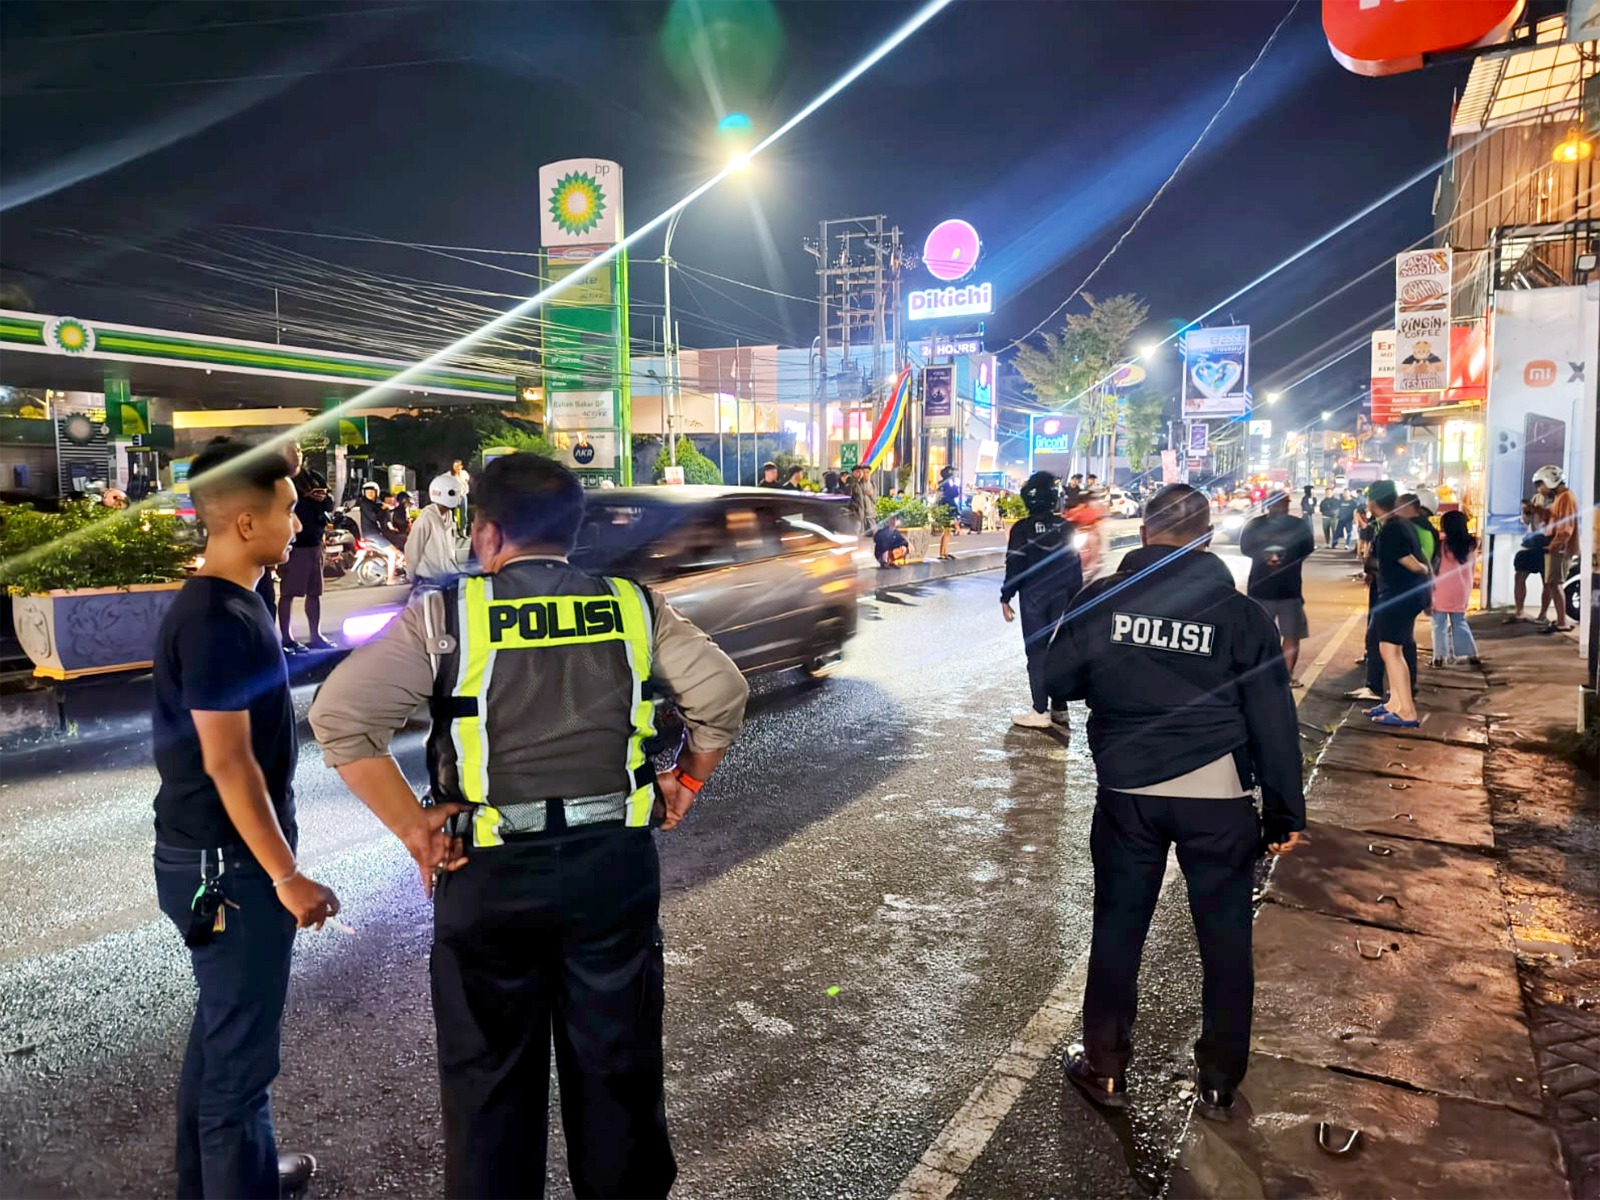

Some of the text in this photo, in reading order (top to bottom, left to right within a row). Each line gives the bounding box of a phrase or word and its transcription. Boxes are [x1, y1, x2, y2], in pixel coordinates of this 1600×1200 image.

[594, 163, 611, 177] bp
[911, 285, 989, 311] Dikichi
[1405, 329, 1441, 339] COFFEE
[937, 342, 977, 355] HOURS
[575, 448, 593, 457] AKR
[488, 599, 624, 642] POLISI
[1112, 614, 1213, 653] POLISI
